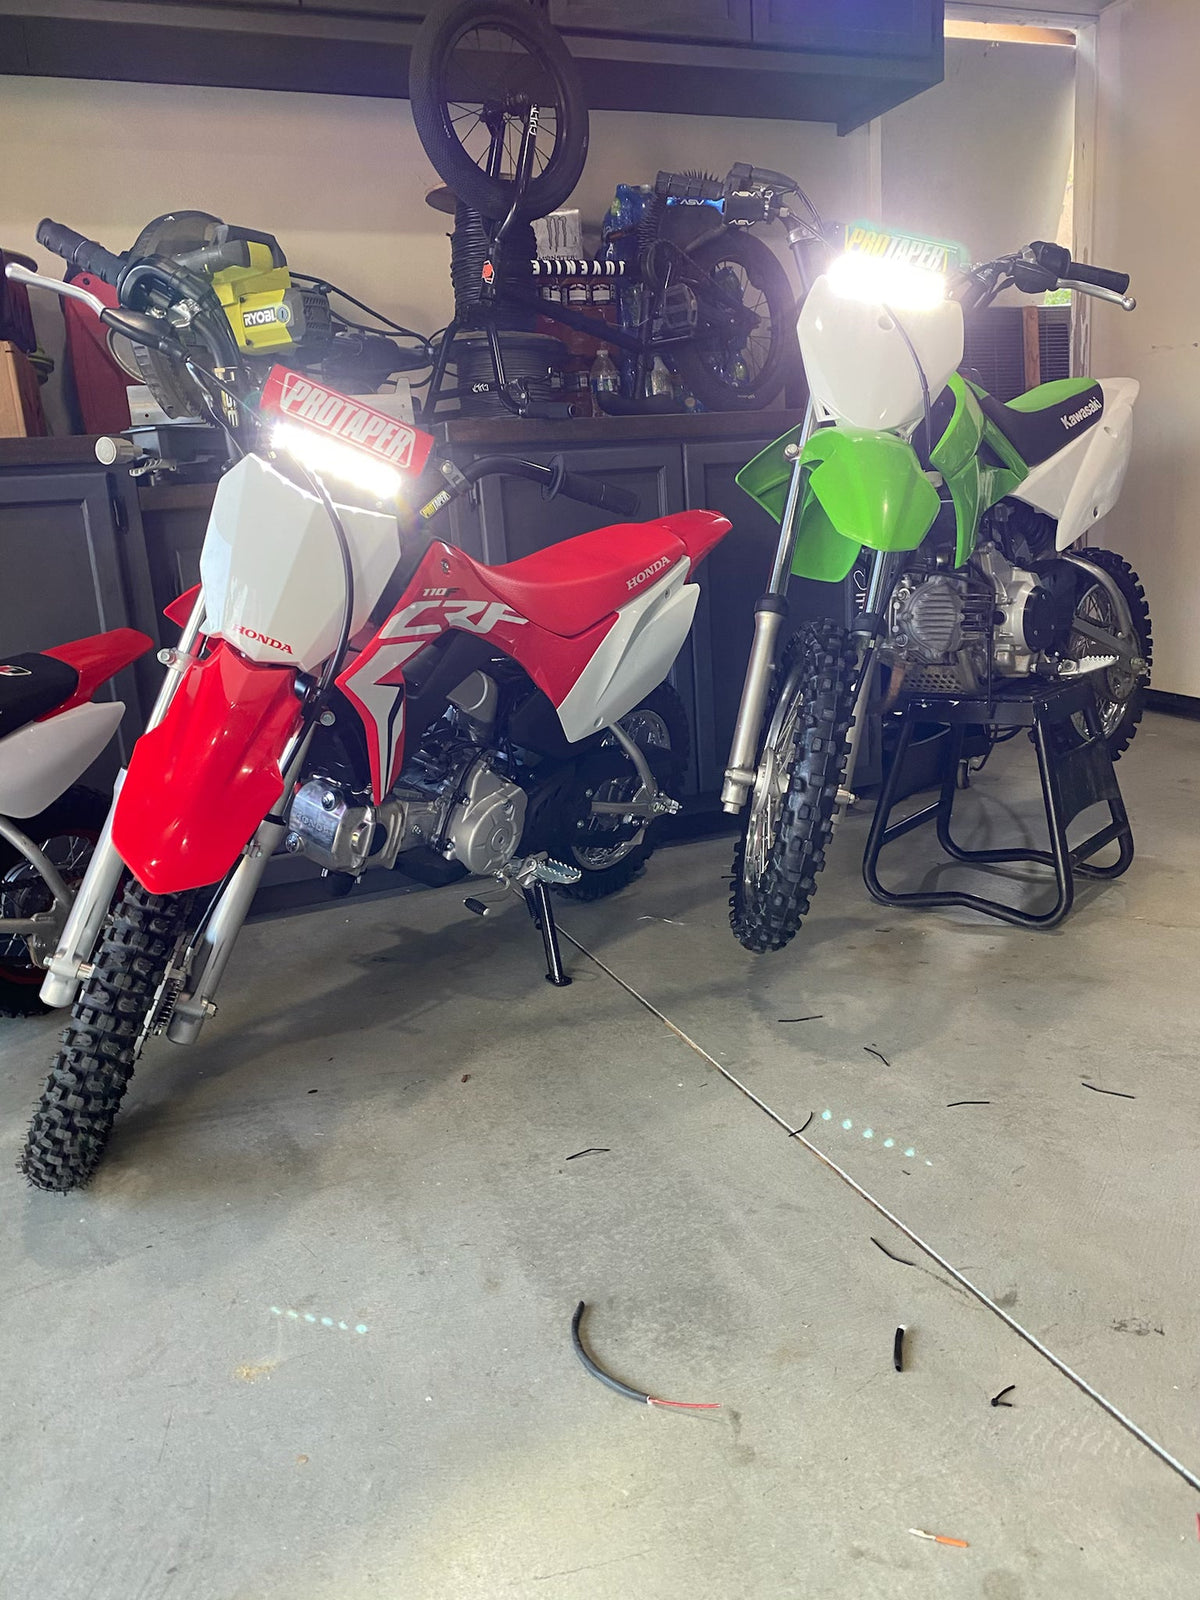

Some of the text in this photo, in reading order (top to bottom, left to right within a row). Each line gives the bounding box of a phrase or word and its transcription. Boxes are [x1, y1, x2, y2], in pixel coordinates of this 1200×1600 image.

[530, 259, 625, 275] JUVENILE
[283, 380, 412, 463] PROTAPER
[1060, 396, 1102, 430] Kawasaki
[626, 556, 671, 590] HONDA
[378, 600, 530, 639] CRF
[232, 623, 294, 655] HONDA
